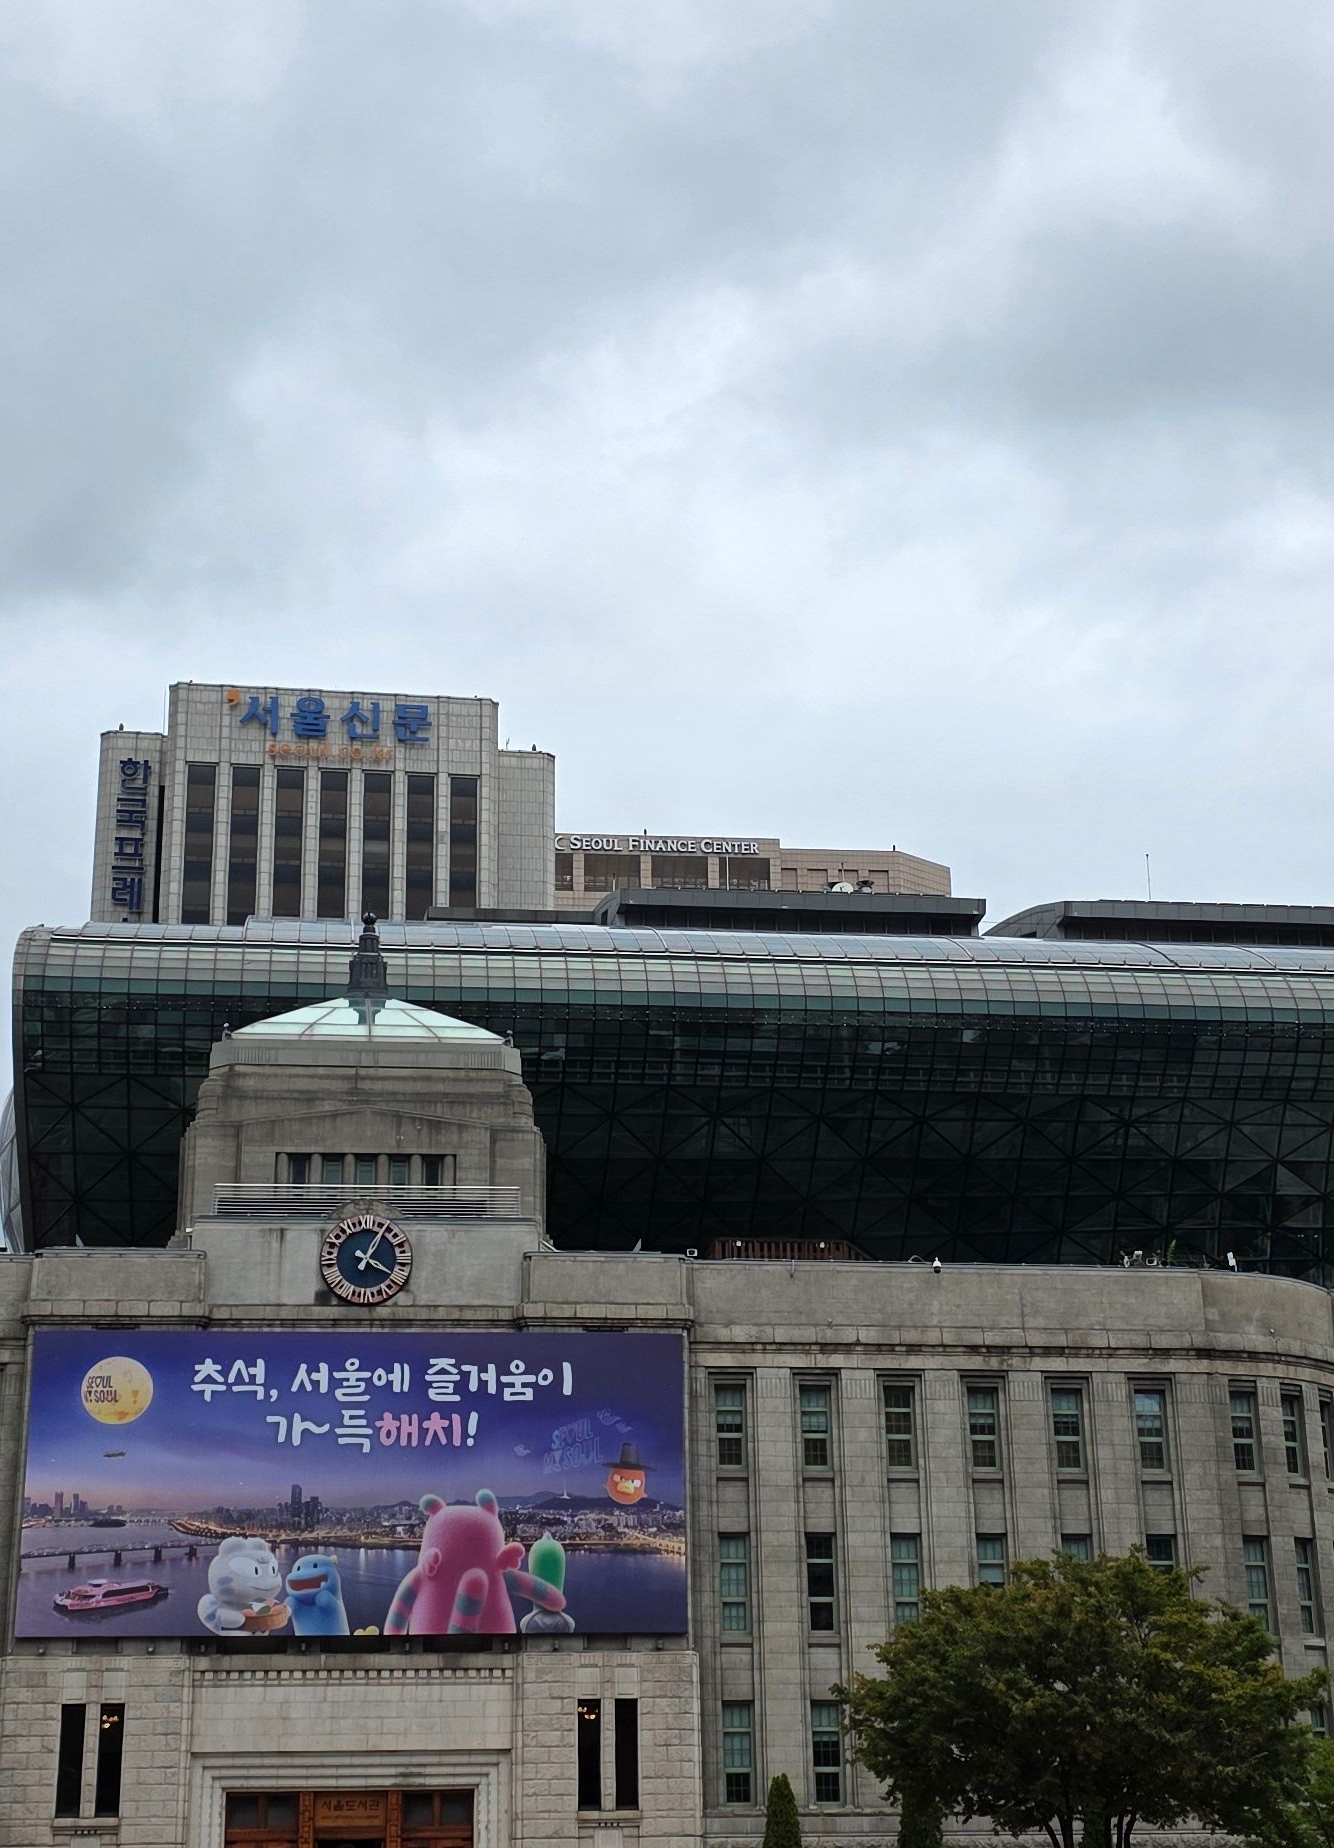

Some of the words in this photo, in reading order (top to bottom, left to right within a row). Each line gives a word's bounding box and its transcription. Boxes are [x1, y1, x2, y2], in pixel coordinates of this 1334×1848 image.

[239, 695, 433, 742] 서울신문
[111, 757, 152, 922] 한국프레
[569, 835, 623, 851] SEOUL
[628, 837, 697, 852] FINANCE
[700, 839, 760, 854] CENTER
[191, 1358, 278, 1402] 추석,
[291, 1359, 410, 1401] 서울에
[425, 1357, 573, 1401] 즐거움이
